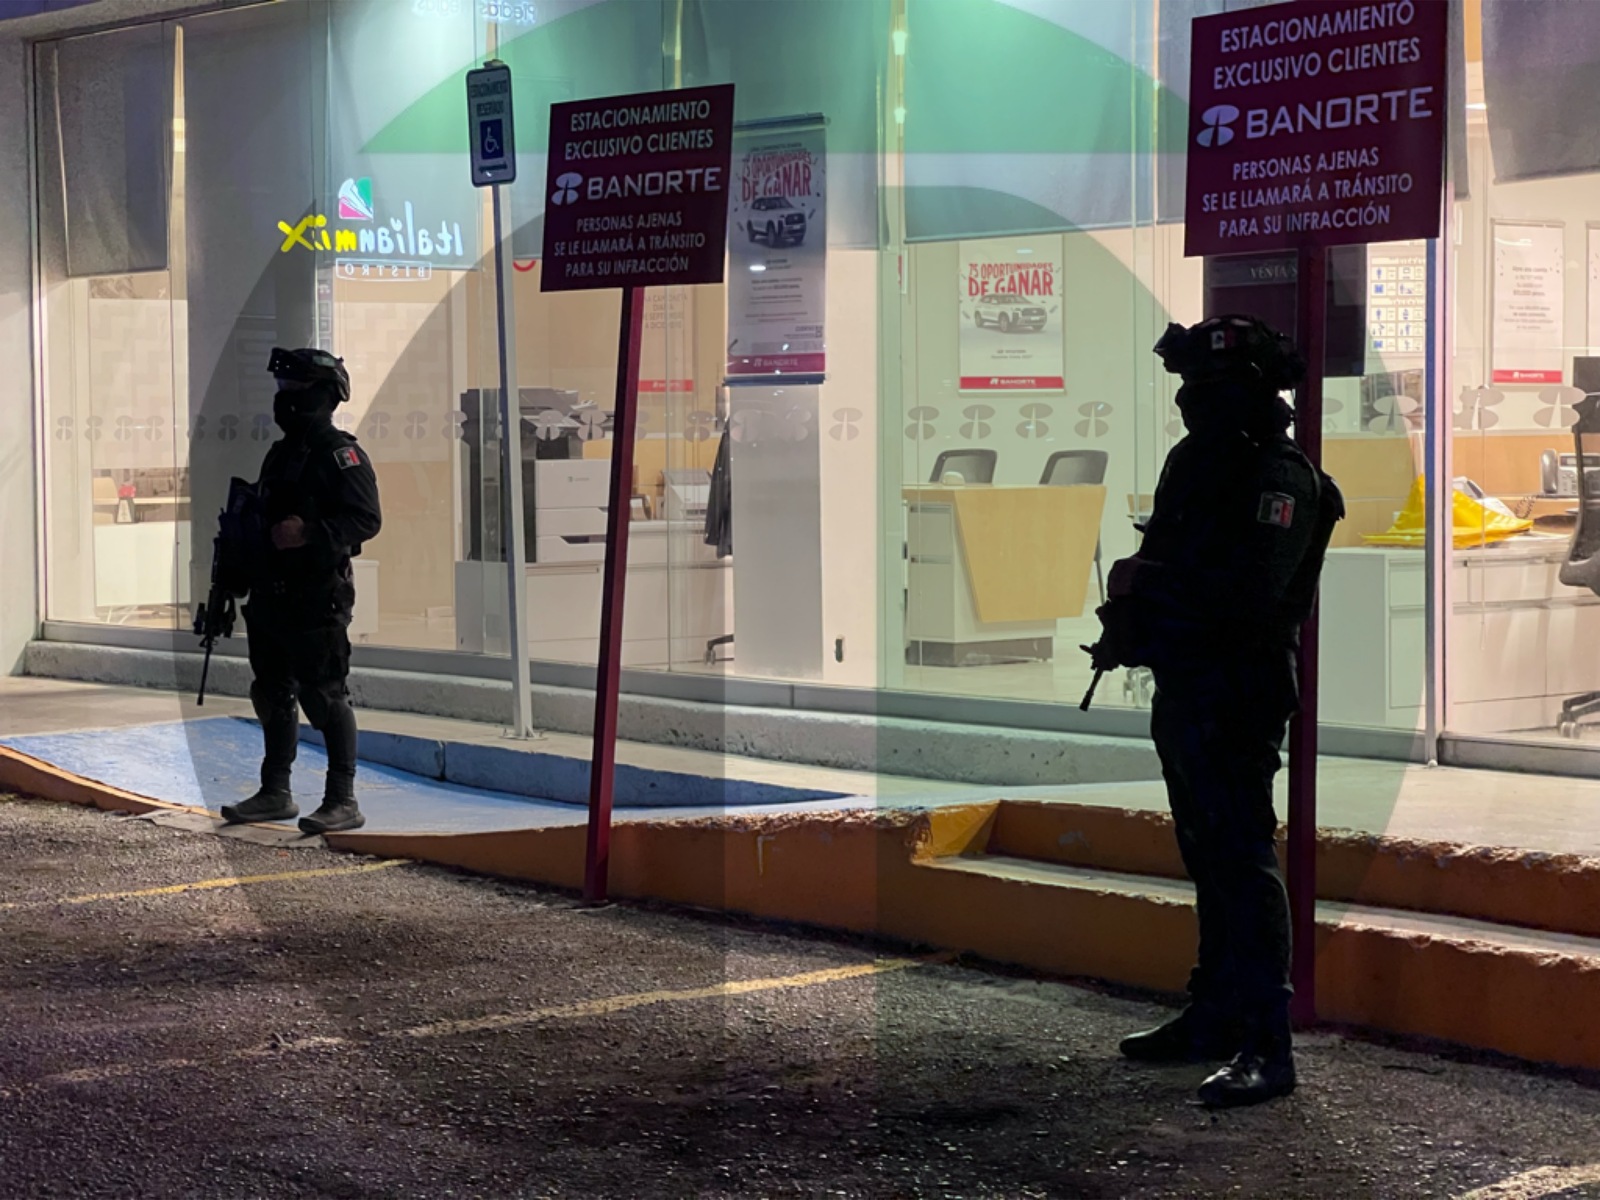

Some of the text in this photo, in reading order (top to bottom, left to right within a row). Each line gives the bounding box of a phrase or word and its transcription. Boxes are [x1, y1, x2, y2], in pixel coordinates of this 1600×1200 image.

[1221, 0, 1414, 53] ESTACIONAMIENTO
[1213, 37, 1420, 90] EXCLUSIVO CLIENTES
[571, 100, 710, 132] ESTACIONAMIENTO
[1246, 86, 1433, 139] BANORTE
[565, 129, 713, 160] EXCLUSIVO CLIENTES
[764, 161, 811, 197] GANAR
[1233, 147, 1379, 181] PERSONAS AJENAS
[587, 167, 721, 200] BANORTE
[1202, 172, 1413, 212] SE LE LLAMARÁ A TRÁNSITO
[577, 211, 682, 232] PERSONAS AJENAS
[1219, 201, 1390, 238] PARA SU INFRACCIÓN
[554, 230, 705, 256] SE LE LLAMARÁ A TRÁNSITO
[565, 254, 689, 277] PARA SU INFRACCIÓN
[980, 262, 1053, 279] OPORTUNIDADES
[968, 270, 1053, 297] DE GANAR
